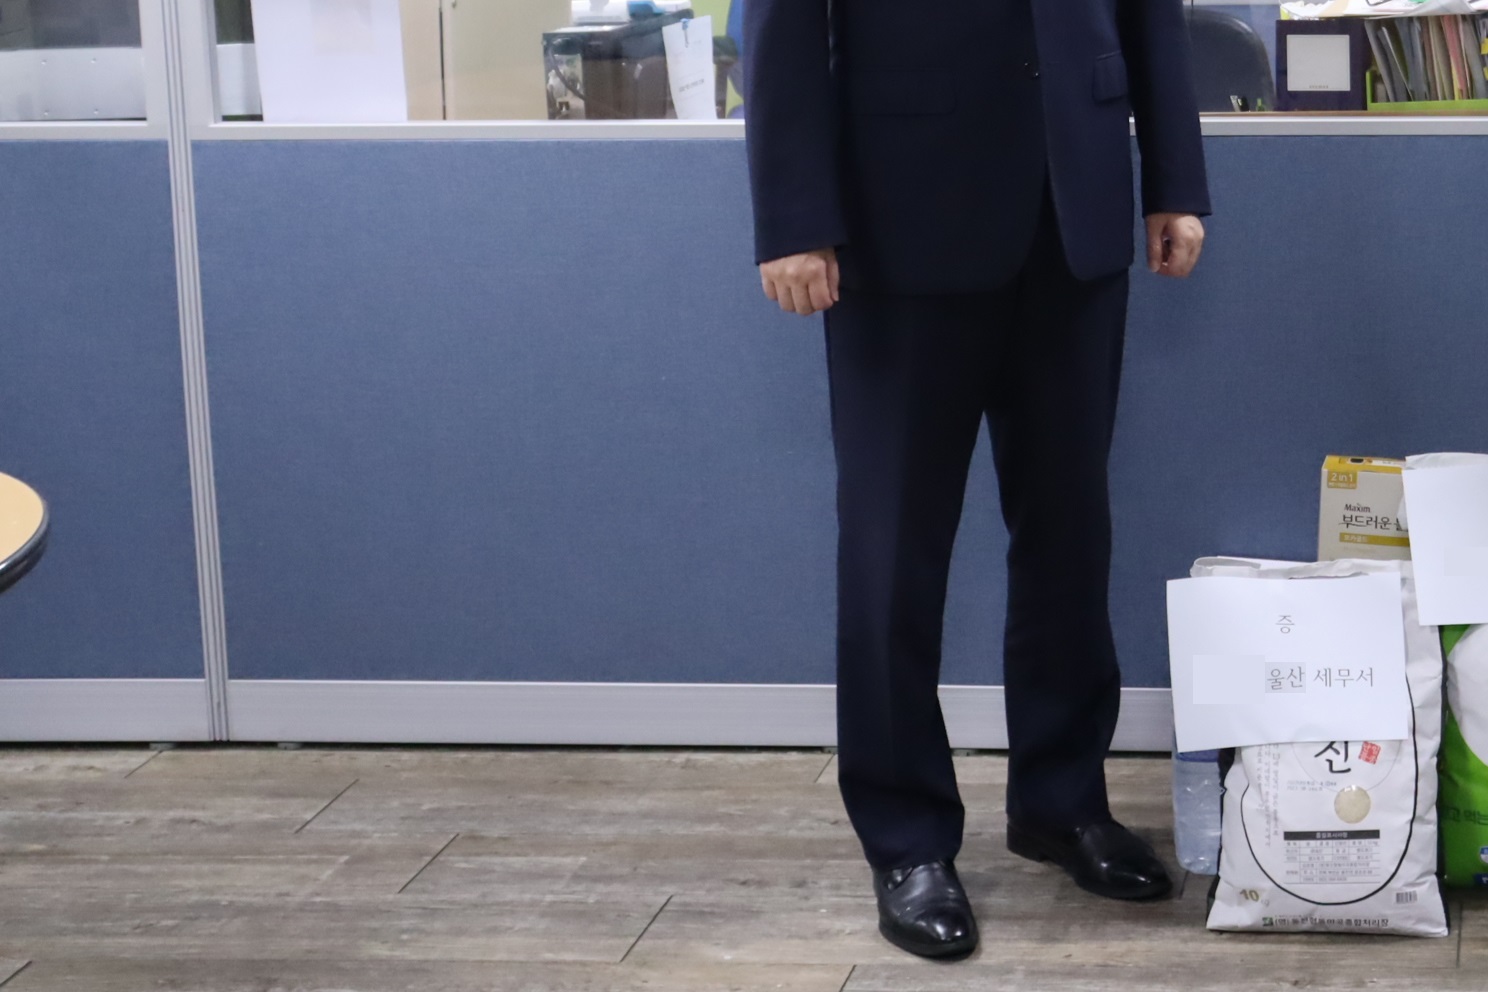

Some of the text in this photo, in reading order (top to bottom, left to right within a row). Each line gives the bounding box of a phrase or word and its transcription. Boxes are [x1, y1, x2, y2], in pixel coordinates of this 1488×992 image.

[1331, 472, 1353, 482] 2 in 1
[1344, 502, 1371, 513] Maxim
[1339, 514, 1392, 530] 부드러운
[1275, 614, 1295, 634] 증
[1267, 666, 1375, 690] 울산 세무서
[1239, 889, 1259, 902] 10
